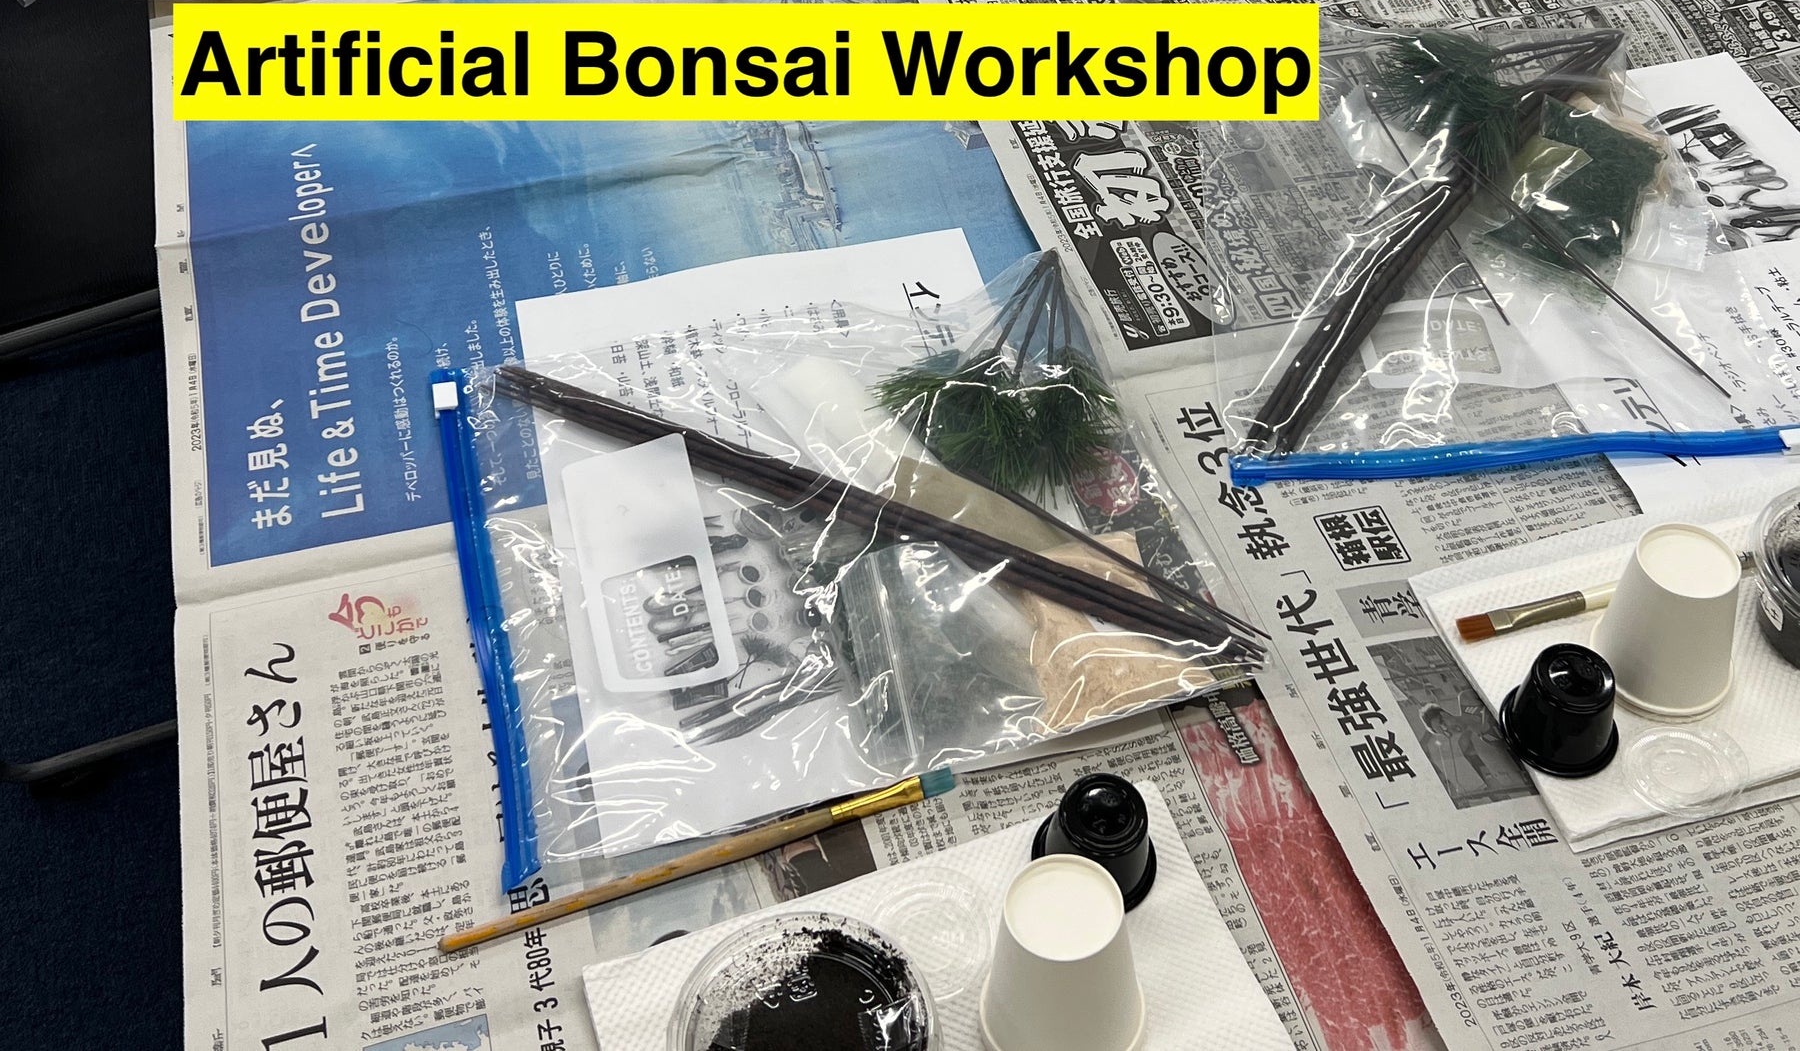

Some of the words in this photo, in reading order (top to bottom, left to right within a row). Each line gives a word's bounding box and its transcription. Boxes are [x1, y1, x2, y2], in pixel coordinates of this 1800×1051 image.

[308, 328, 345, 421] Time
[388, 335, 422, 503] デベロッパーに感動はつくれるのか。
[245, 398, 293, 530] まだ見ぬ、
[320, 416, 356, 443] &
[320, 445, 366, 521] Life
[621, 576, 656, 675] CONTENTS:
[671, 565, 691, 619] DATE:
[359, 643, 371, 655] 2
[1276, 567, 1414, 811] 「最強世代」
[243, 641, 328, 1051] 1人の郵便屋さん
[1407, 818, 1559, 870] エース全開
